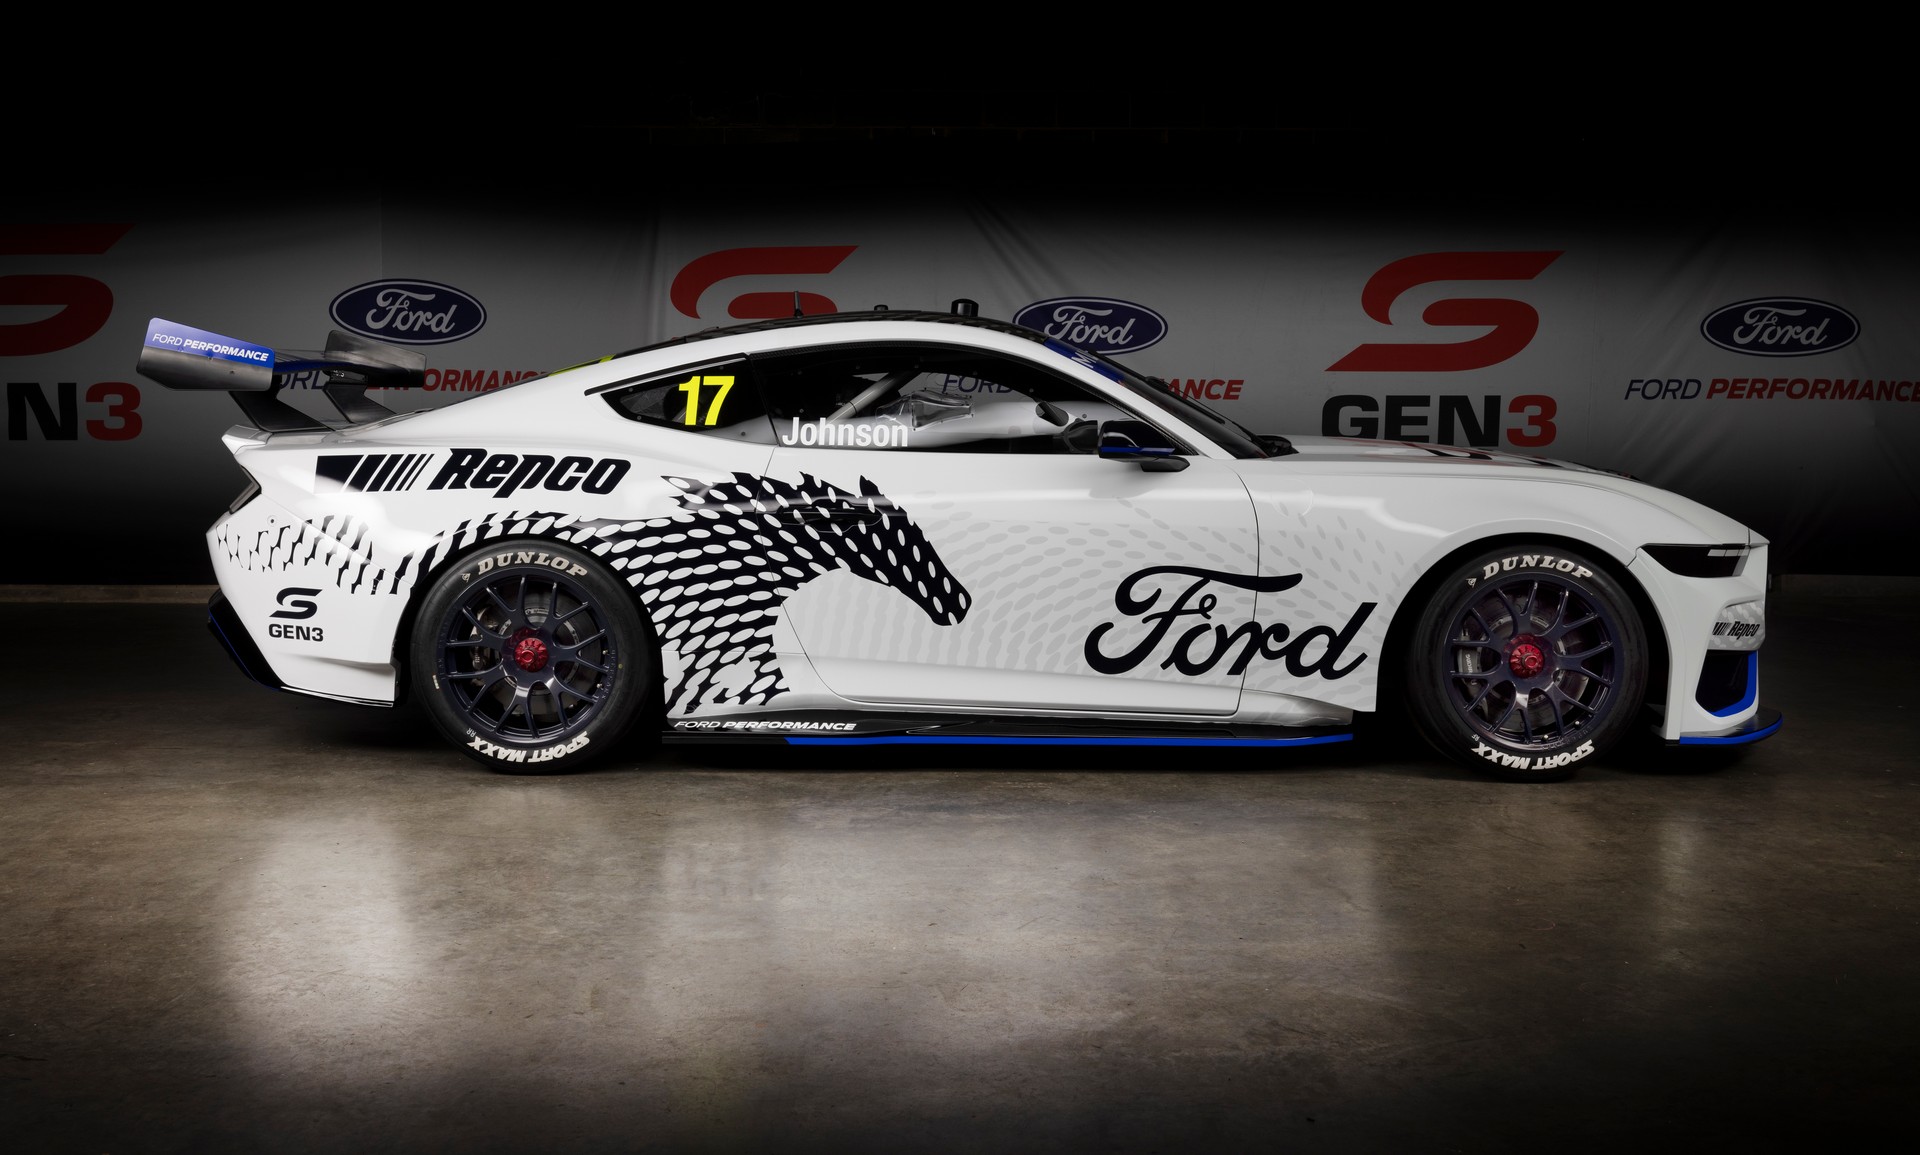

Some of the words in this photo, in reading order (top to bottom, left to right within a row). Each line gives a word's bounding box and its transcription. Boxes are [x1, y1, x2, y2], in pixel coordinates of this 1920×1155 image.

[366, 288, 457, 335] Ford
[1043, 305, 1136, 346] Ford
[1733, 306, 1831, 346] Ford
[152, 333, 183, 347] FORD
[183, 338, 269, 363] PERFORMANCE
[677, 375, 735, 426] 17
[1624, 378, 1702, 400] FORD
[781, 416, 909, 447] Johnson
[1321, 394, 1558, 448] GEN3
[426, 448, 631, 499] Repco
[477, 551, 588, 577] DUNLOP
[1483, 554, 1594, 580] DUNLOP
[268, 623, 324, 642] GEN3
[1084, 564, 1378, 680] Ford
[1727, 621, 1760, 640] Repco
[673, 720, 721, 729] FORD
[721, 720, 858, 731] PERFORMANCE
[466, 736, 527, 763] MAXX
[527, 731, 591, 763] SPORT
[1470, 741, 1531, 770] MAXX
[1531, 739, 1595, 771] SPORT
